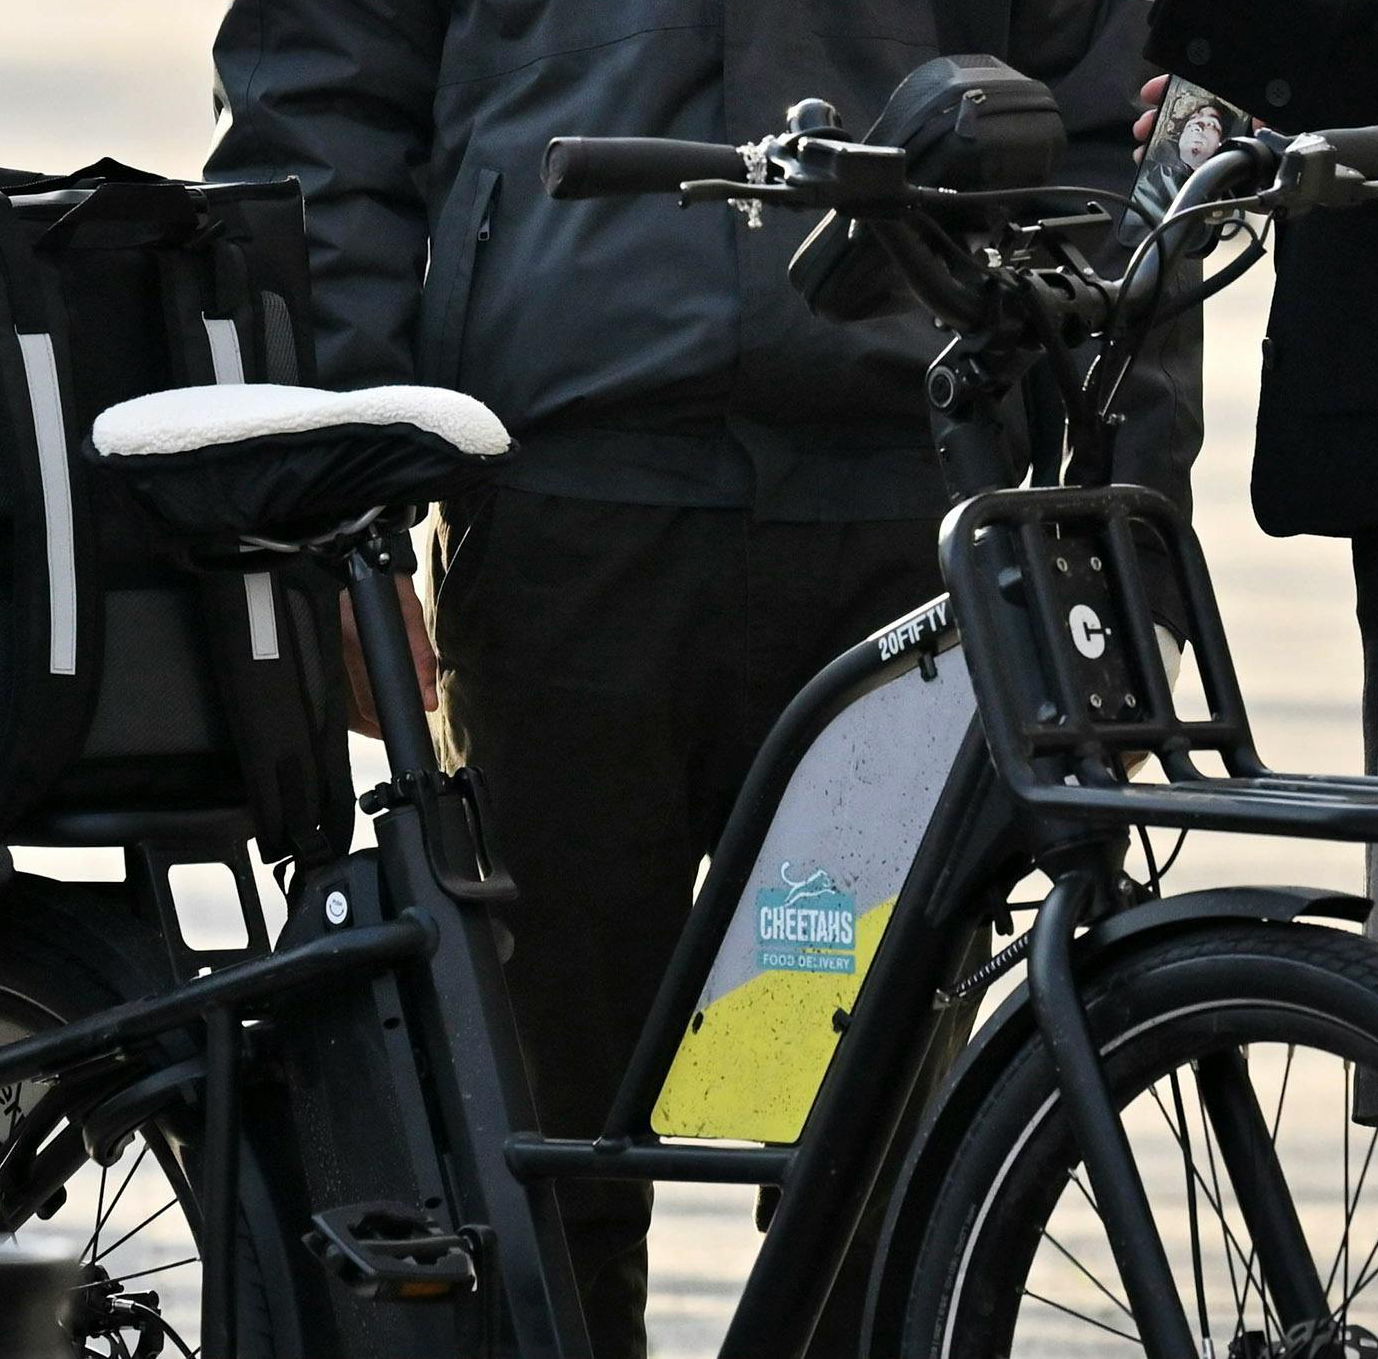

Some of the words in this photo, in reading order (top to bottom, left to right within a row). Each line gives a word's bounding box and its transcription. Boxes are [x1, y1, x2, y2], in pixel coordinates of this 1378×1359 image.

[877, 601, 948, 662] 20FIFTY
[759, 905, 853, 945] CHEETAHS
[762, 953, 795, 967] FOOD
[797, 955, 850, 970] DELIVERY
